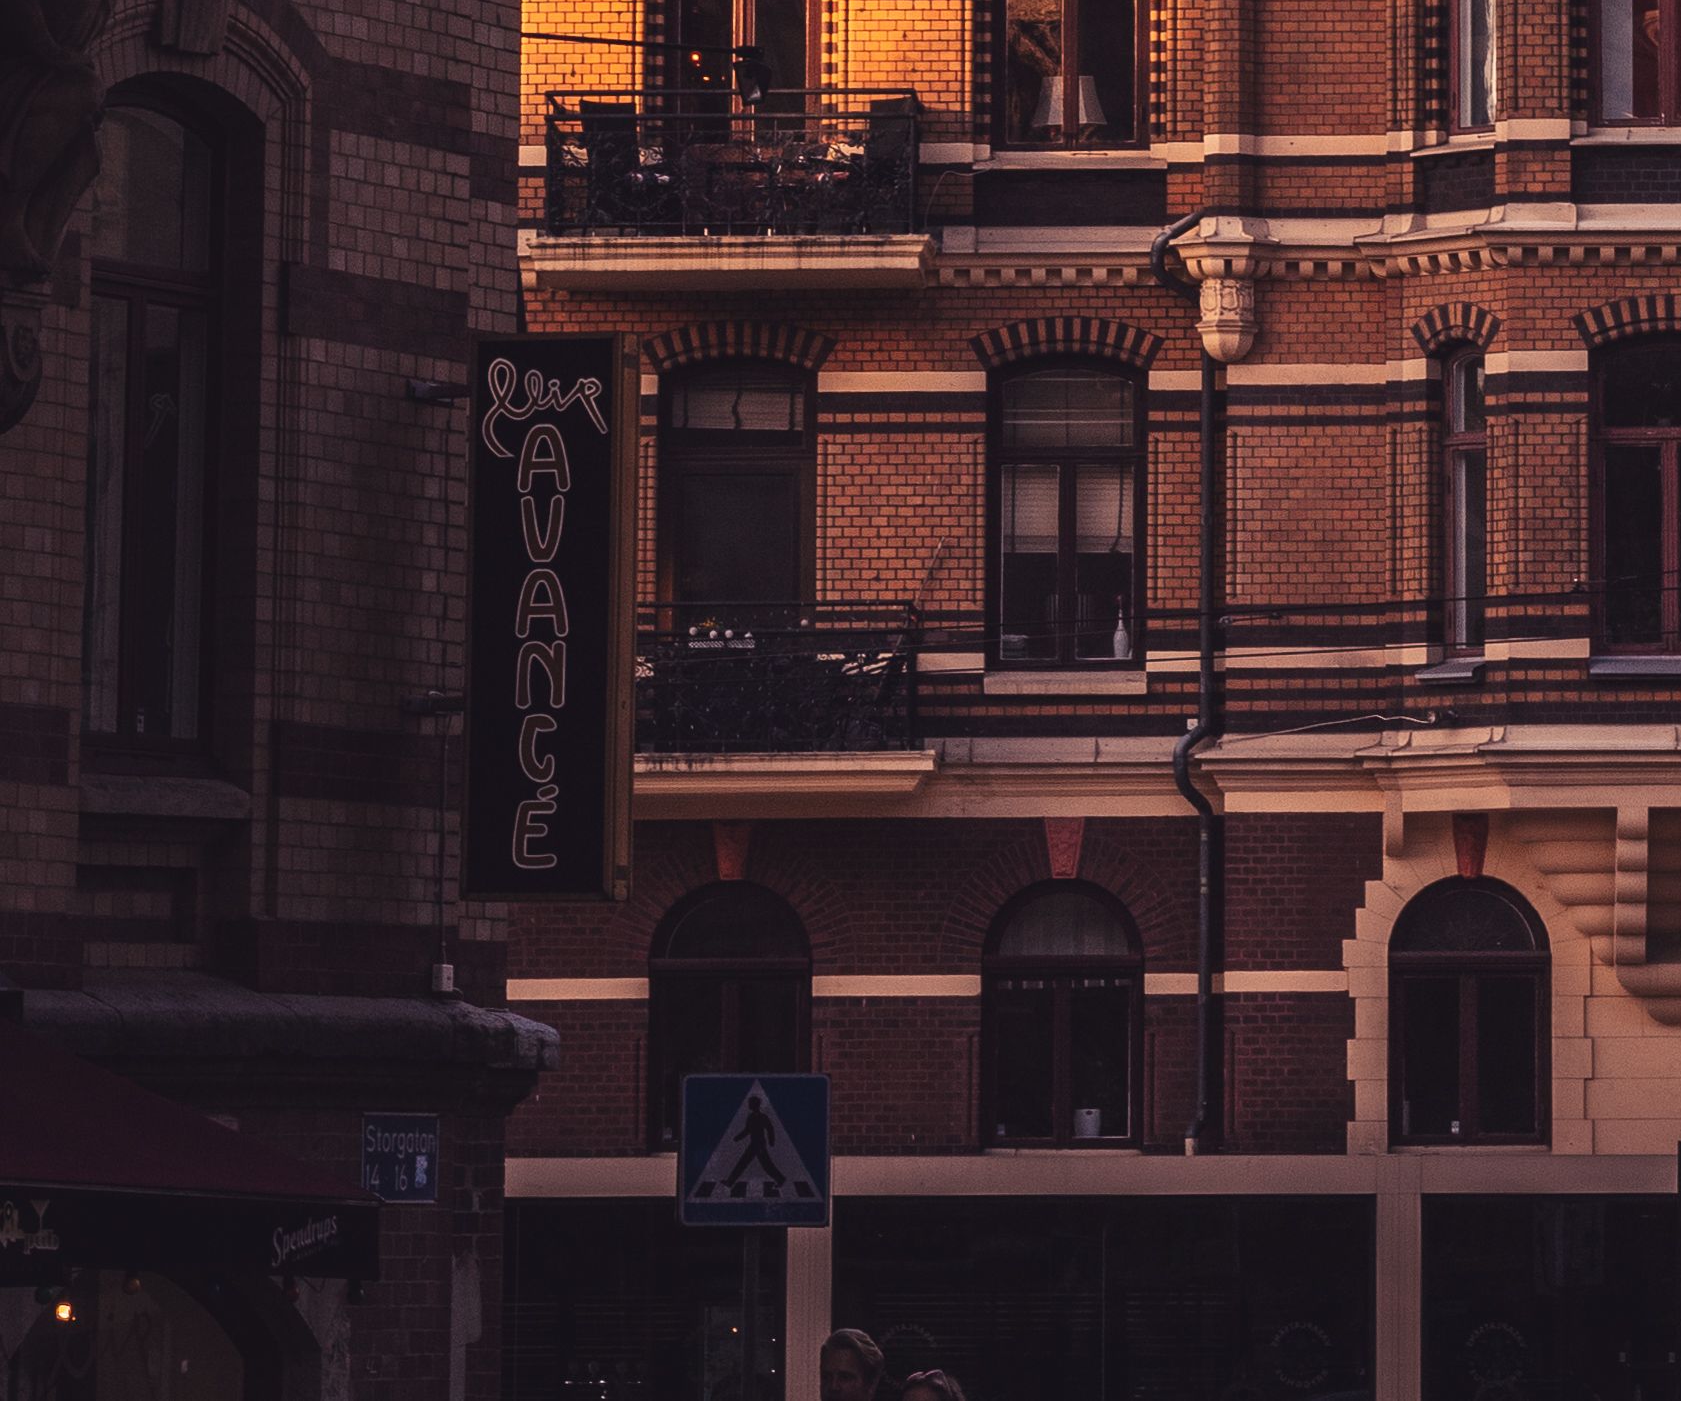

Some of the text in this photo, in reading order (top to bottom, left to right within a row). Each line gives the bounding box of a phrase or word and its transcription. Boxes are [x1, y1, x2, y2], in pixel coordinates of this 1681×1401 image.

[512, 423, 571, 868] AVANCÉ
[366, 1124, 436, 1159] Storgatan
[366, 1163, 408, 1191] 14 16
[271, 1215, 338, 1269] Spendrups
